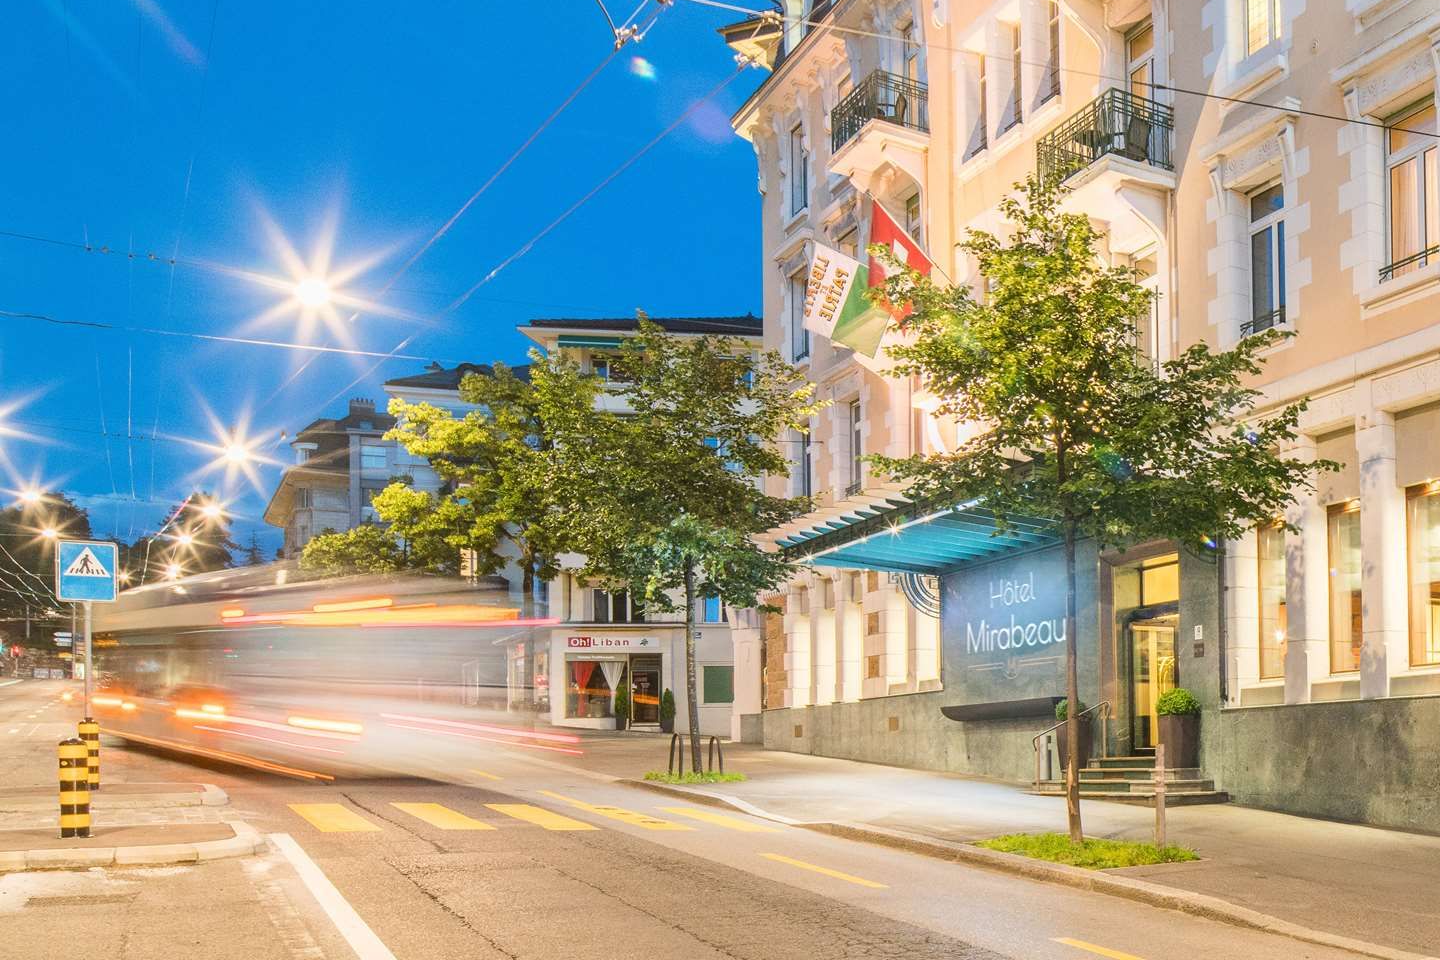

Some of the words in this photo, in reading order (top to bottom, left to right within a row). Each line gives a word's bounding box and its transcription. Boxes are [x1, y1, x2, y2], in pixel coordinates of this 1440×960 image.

[990, 572, 1036, 608] Hôtel
[570, 638, 591, 647] Oh!
[592, 638, 630, 647] Liban
[967, 614, 1066, 654] Mirabeau
